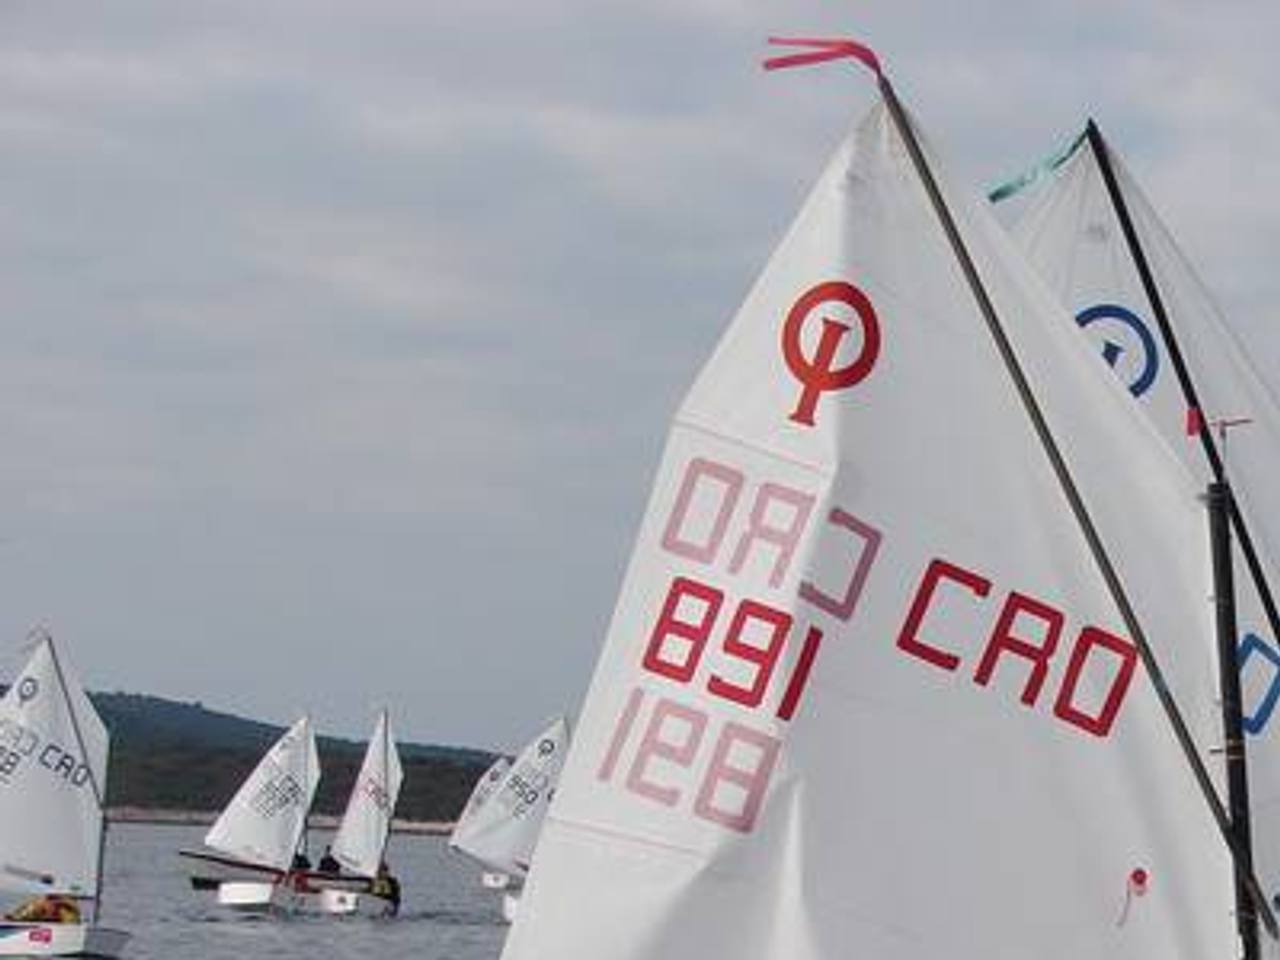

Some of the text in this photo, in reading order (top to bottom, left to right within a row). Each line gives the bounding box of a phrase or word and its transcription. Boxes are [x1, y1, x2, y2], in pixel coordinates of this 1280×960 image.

[642, 576, 823, 721] 891
[896, 559, 1142, 737] CRO
[39, 743, 90, 787] CRO
